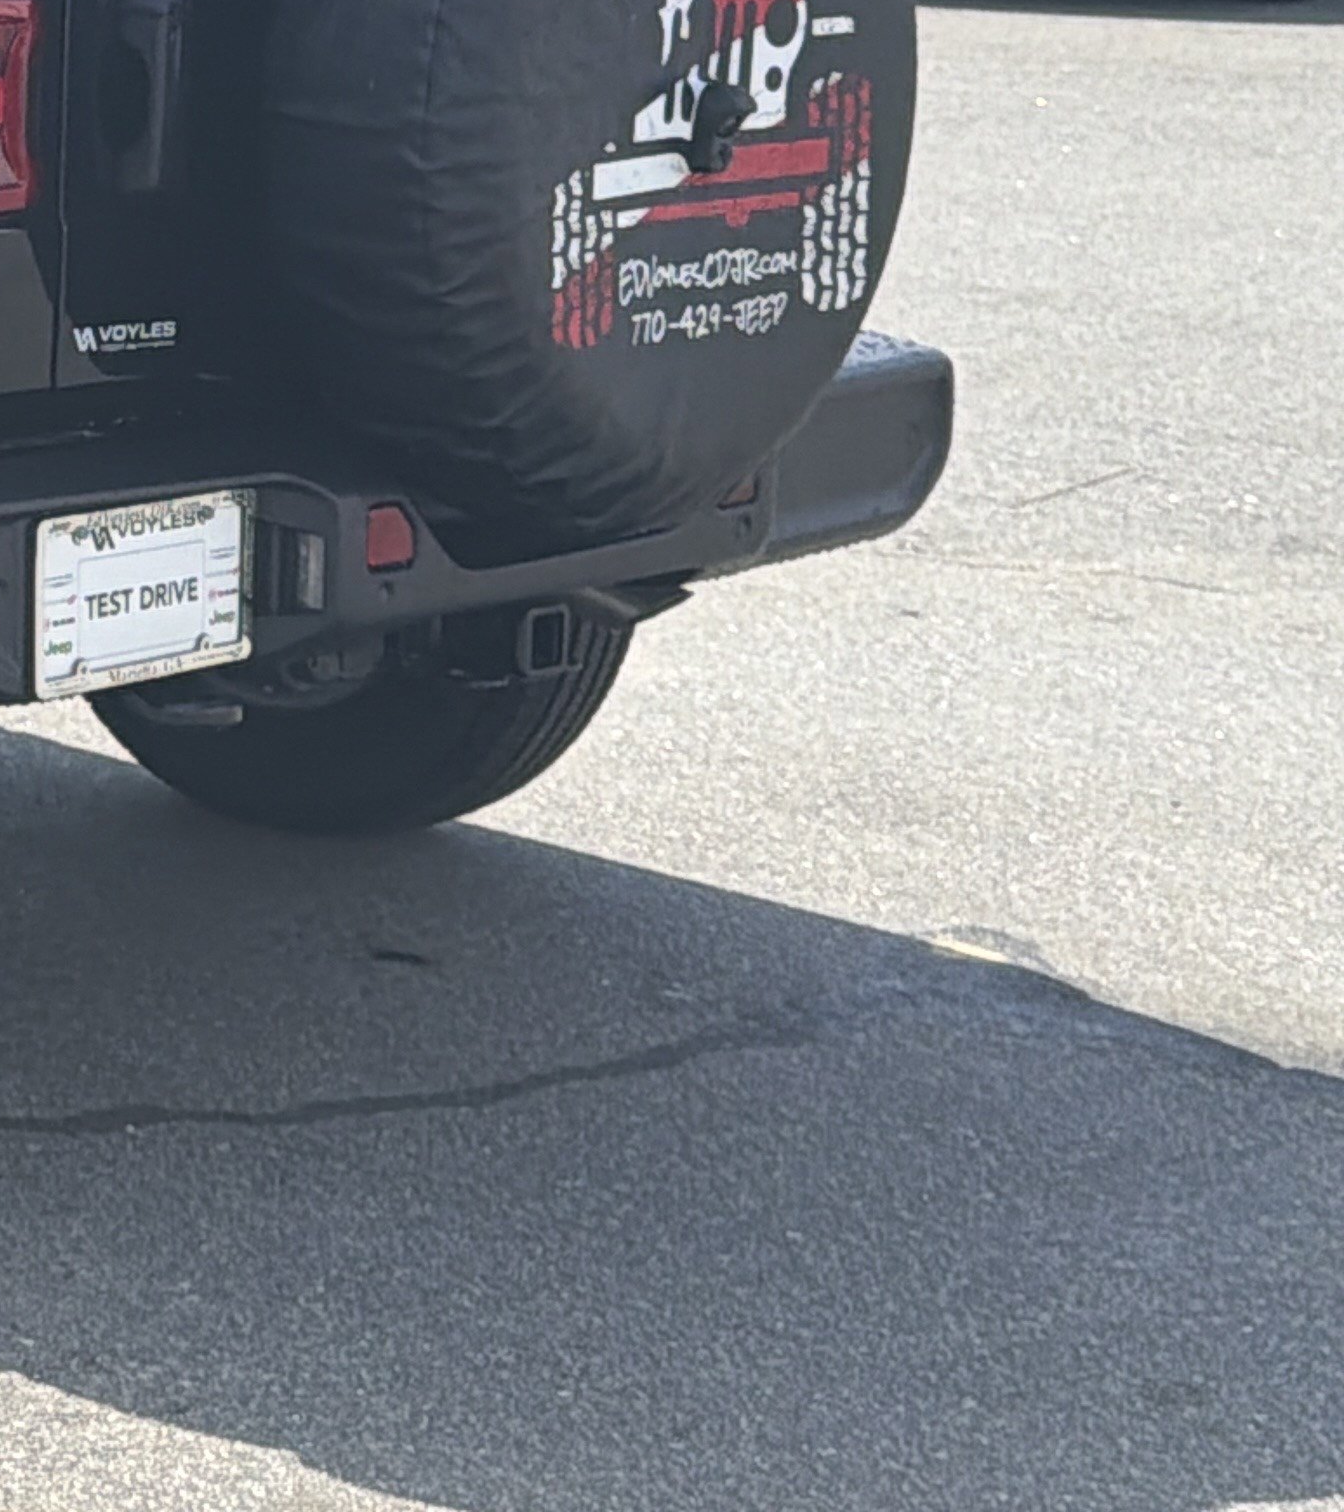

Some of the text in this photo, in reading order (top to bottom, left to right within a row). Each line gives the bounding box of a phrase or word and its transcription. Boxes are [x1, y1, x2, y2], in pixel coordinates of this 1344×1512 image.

[98, 320, 177, 342] VOYLES
[84, 588, 134, 621] TEST
[139, 576, 199, 611] DRIVE
[43, 638, 73, 657] Jeep
